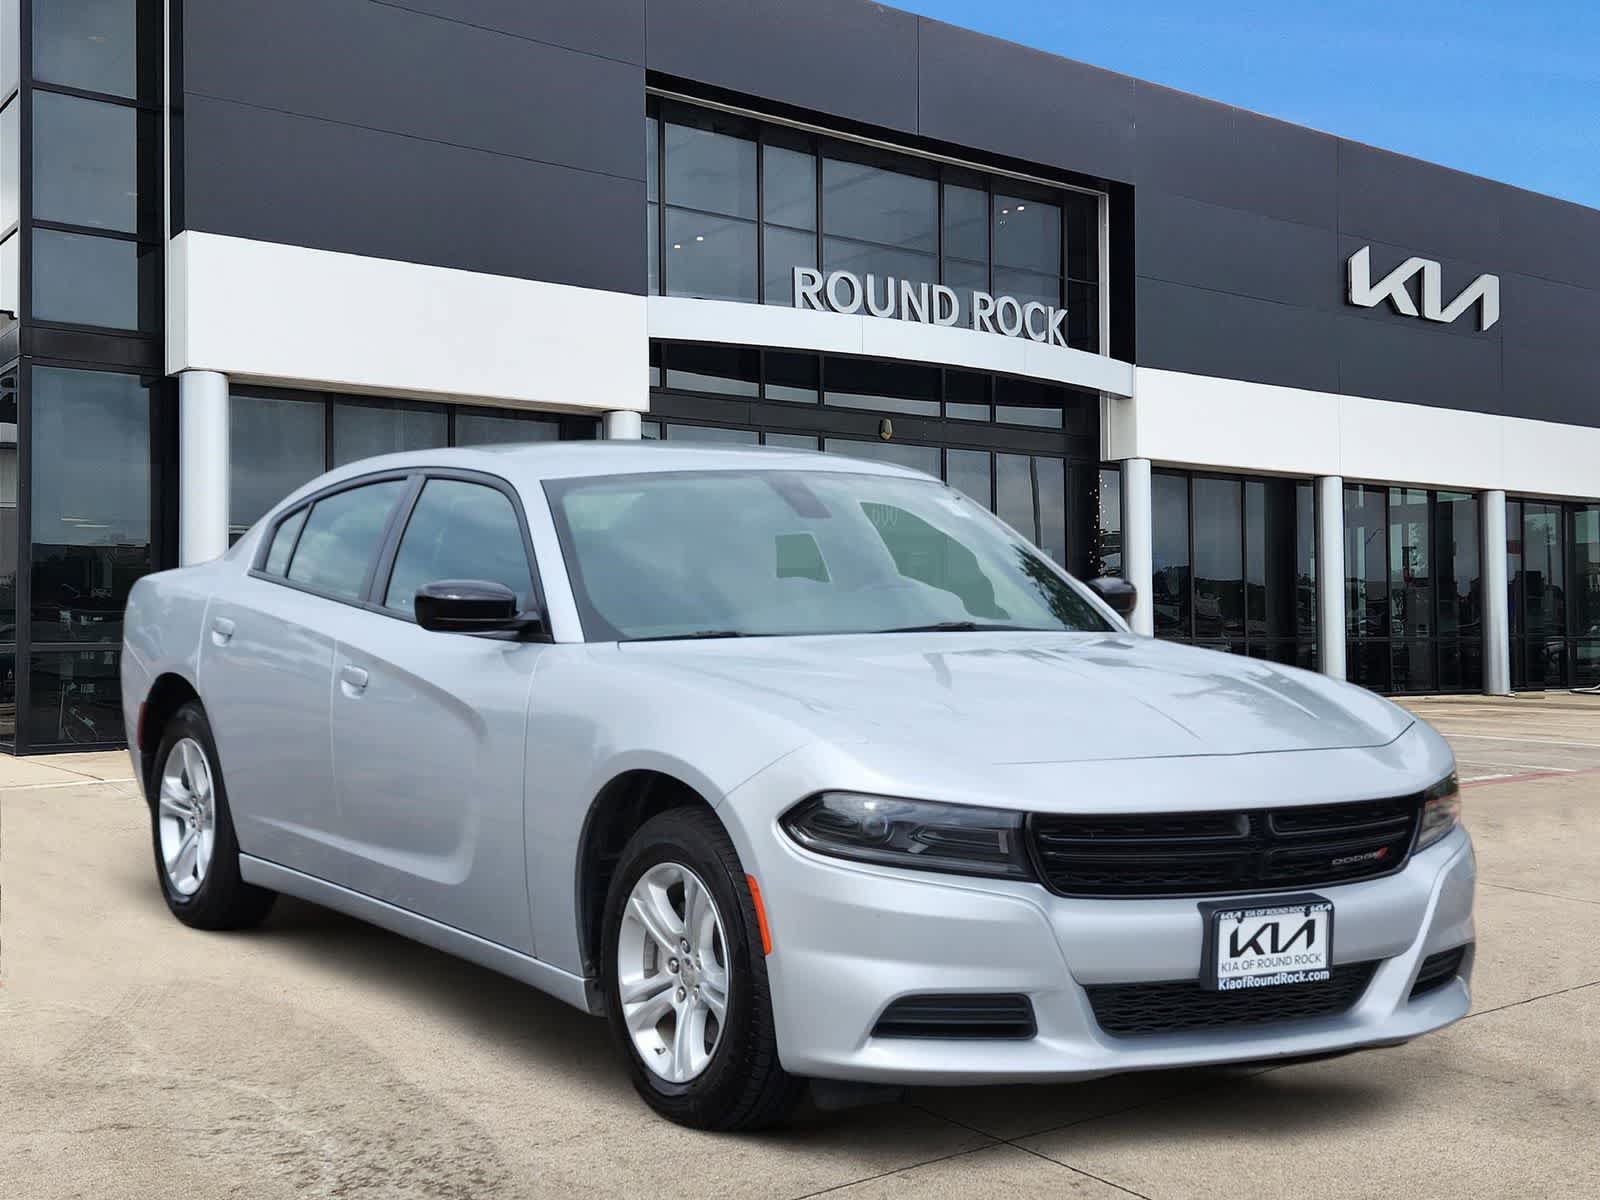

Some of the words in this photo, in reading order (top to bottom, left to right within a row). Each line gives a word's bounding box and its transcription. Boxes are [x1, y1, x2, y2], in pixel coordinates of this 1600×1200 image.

[793, 266, 960, 327] ROUND
[973, 290, 1069, 348] ROCK
[1347, 245, 1500, 331] KIA
[1230, 919, 1315, 958] KIA
[1219, 971, 1330, 990] KiaofRoundRock.com
[1221, 961, 1240, 973] KIA
[1241, 959, 1255, 971] OF
[1257, 956, 1292, 968] ROUND
[1294, 953, 1322, 965] ROCK
